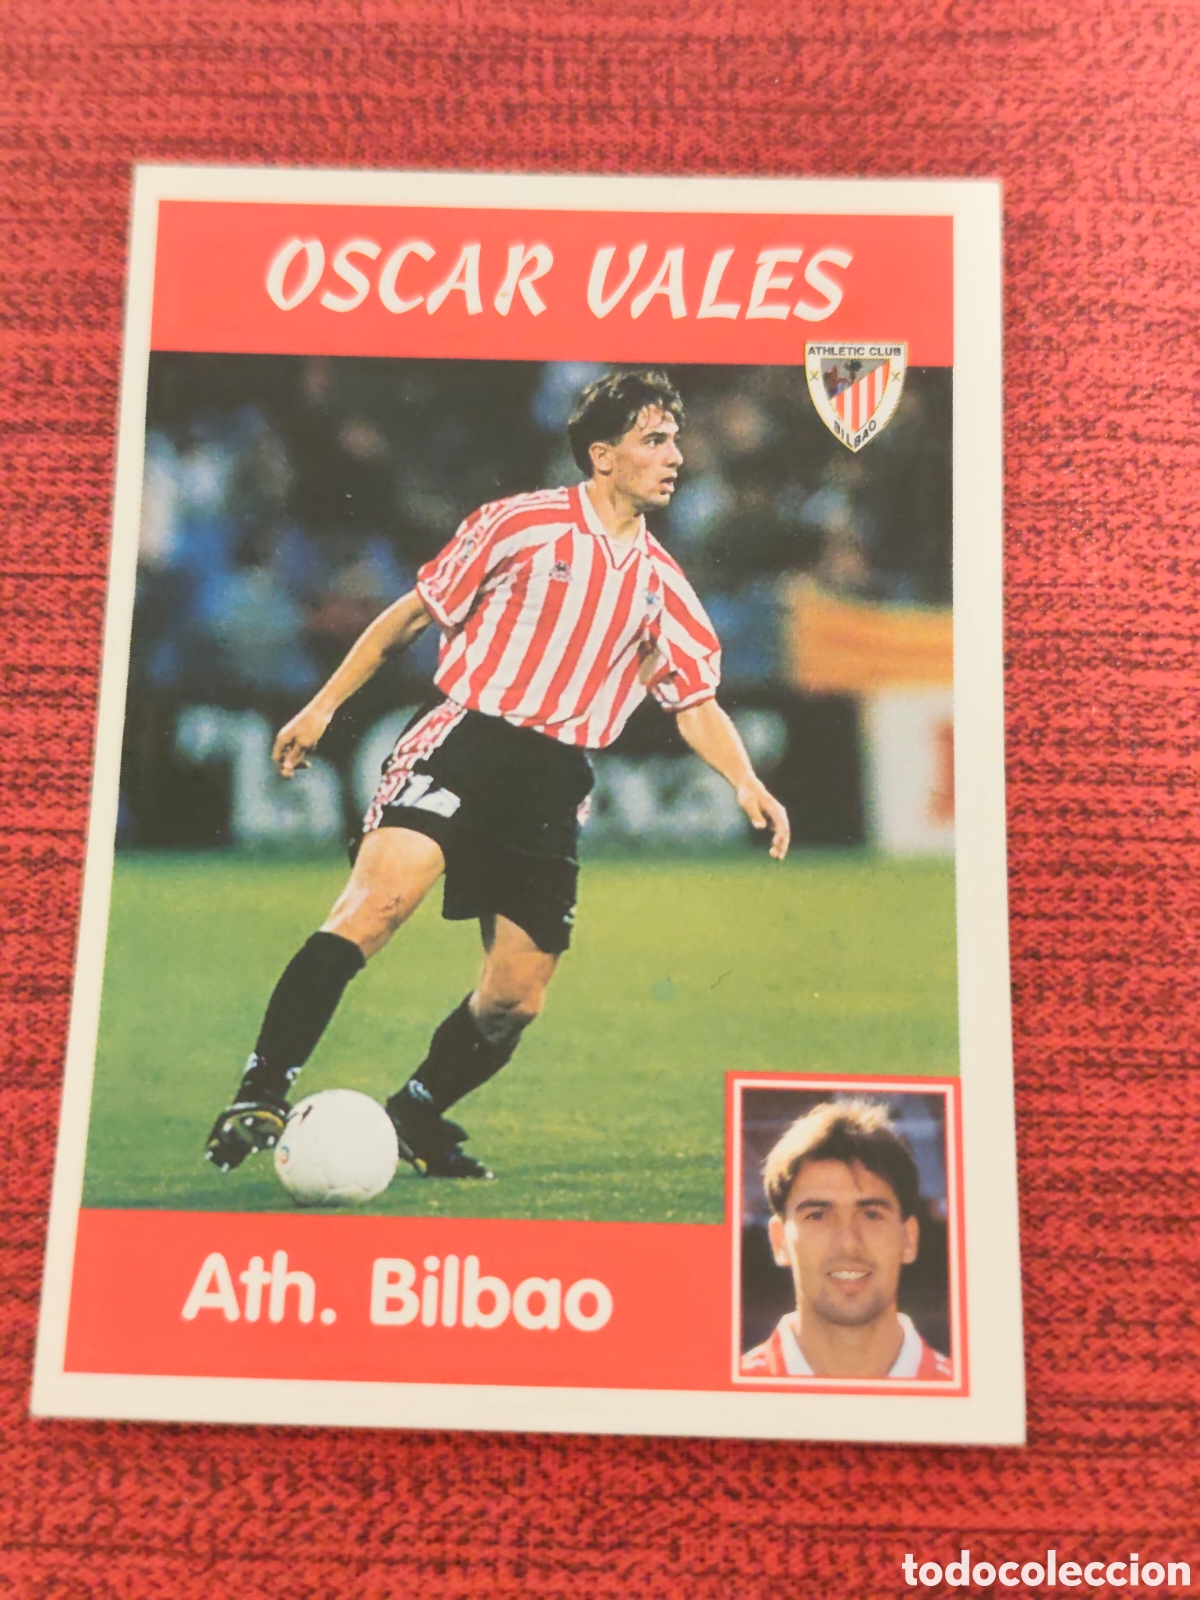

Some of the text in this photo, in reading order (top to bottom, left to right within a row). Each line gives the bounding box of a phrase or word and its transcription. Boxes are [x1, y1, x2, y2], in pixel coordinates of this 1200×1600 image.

[266, 238, 853, 322] OSCAR VALES
[807, 346, 902, 356] ATHLETIC CLUB
[833, 420, 877, 449] BILBAO
[182, 1250, 614, 1332] Ath. Bilbao
